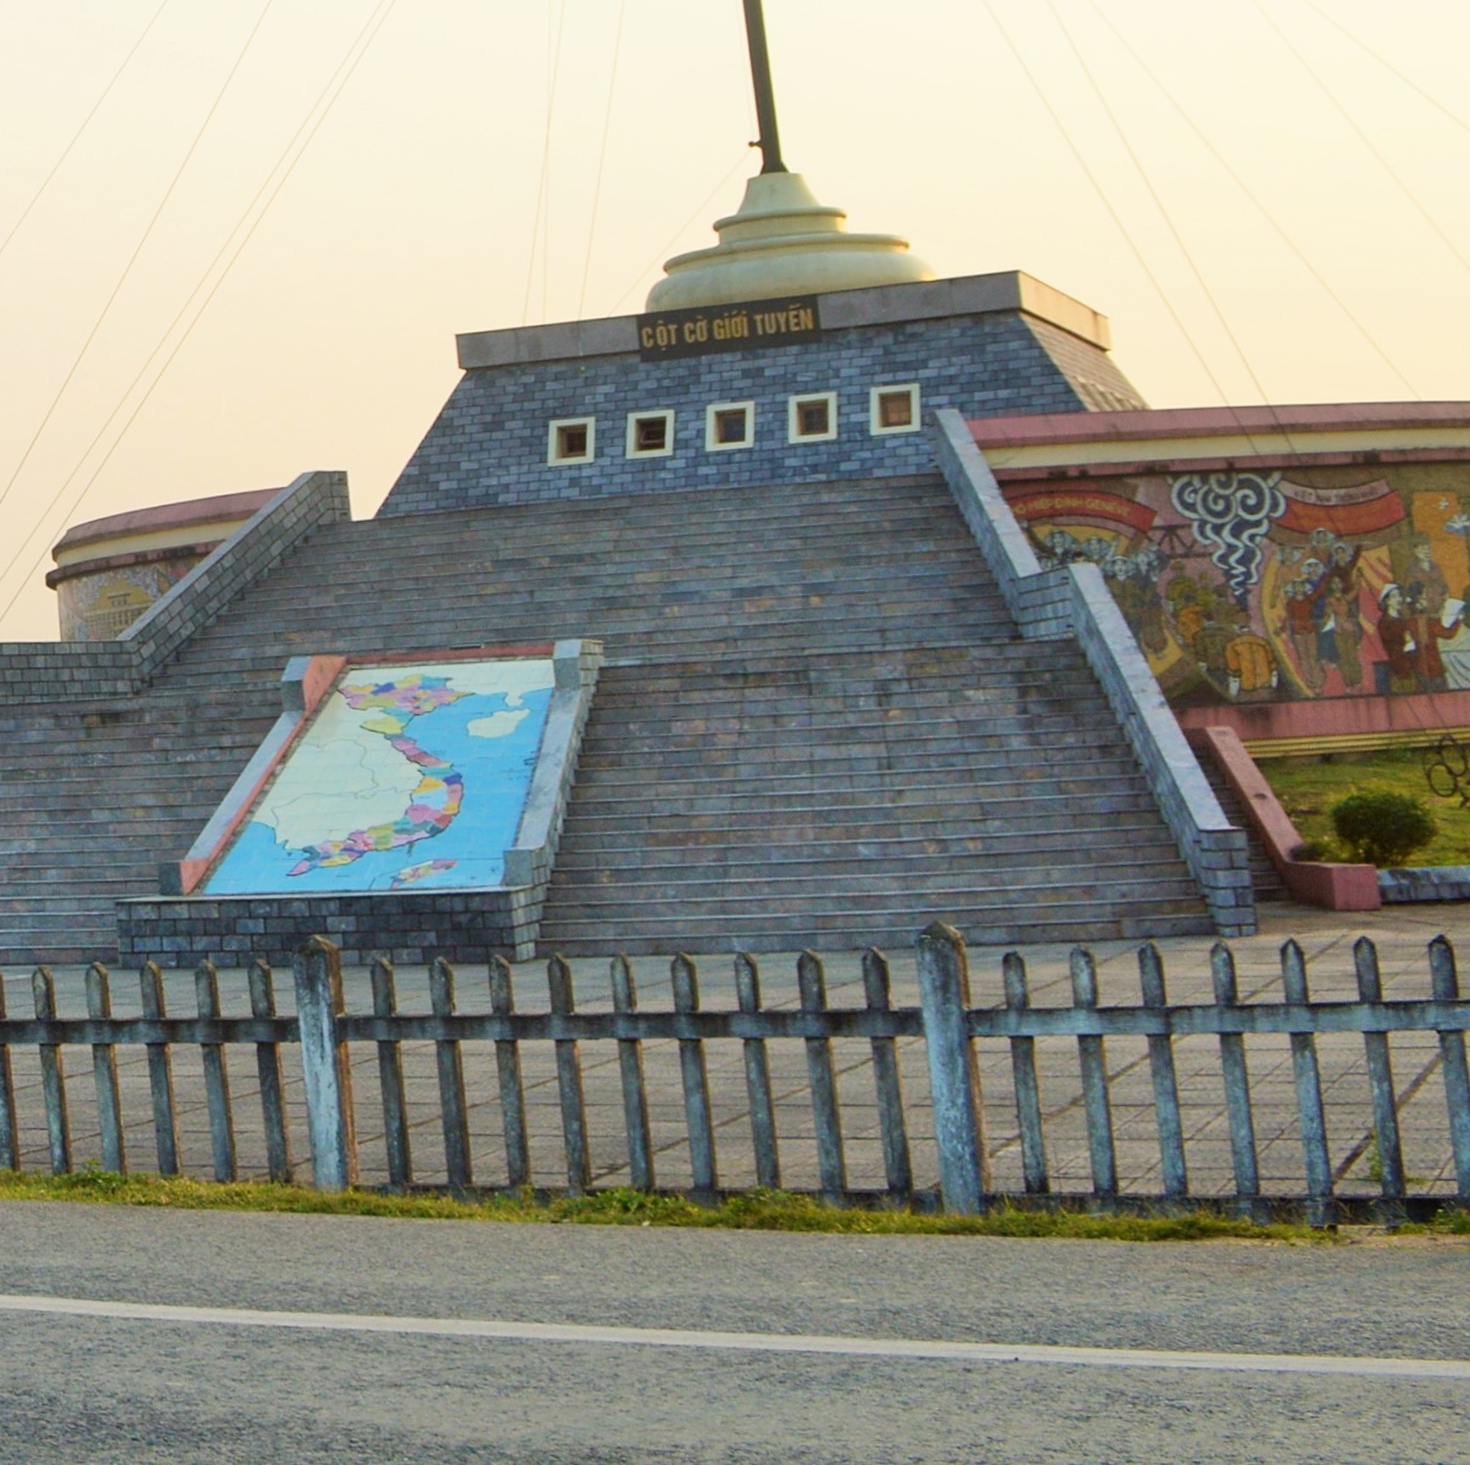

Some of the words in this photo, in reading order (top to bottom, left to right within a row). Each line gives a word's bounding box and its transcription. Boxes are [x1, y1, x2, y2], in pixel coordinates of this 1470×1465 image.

[641, 319, 678, 351] CỘT
[684, 315, 709, 343] CỜ
[754, 303, 814, 335] TUYẾN
